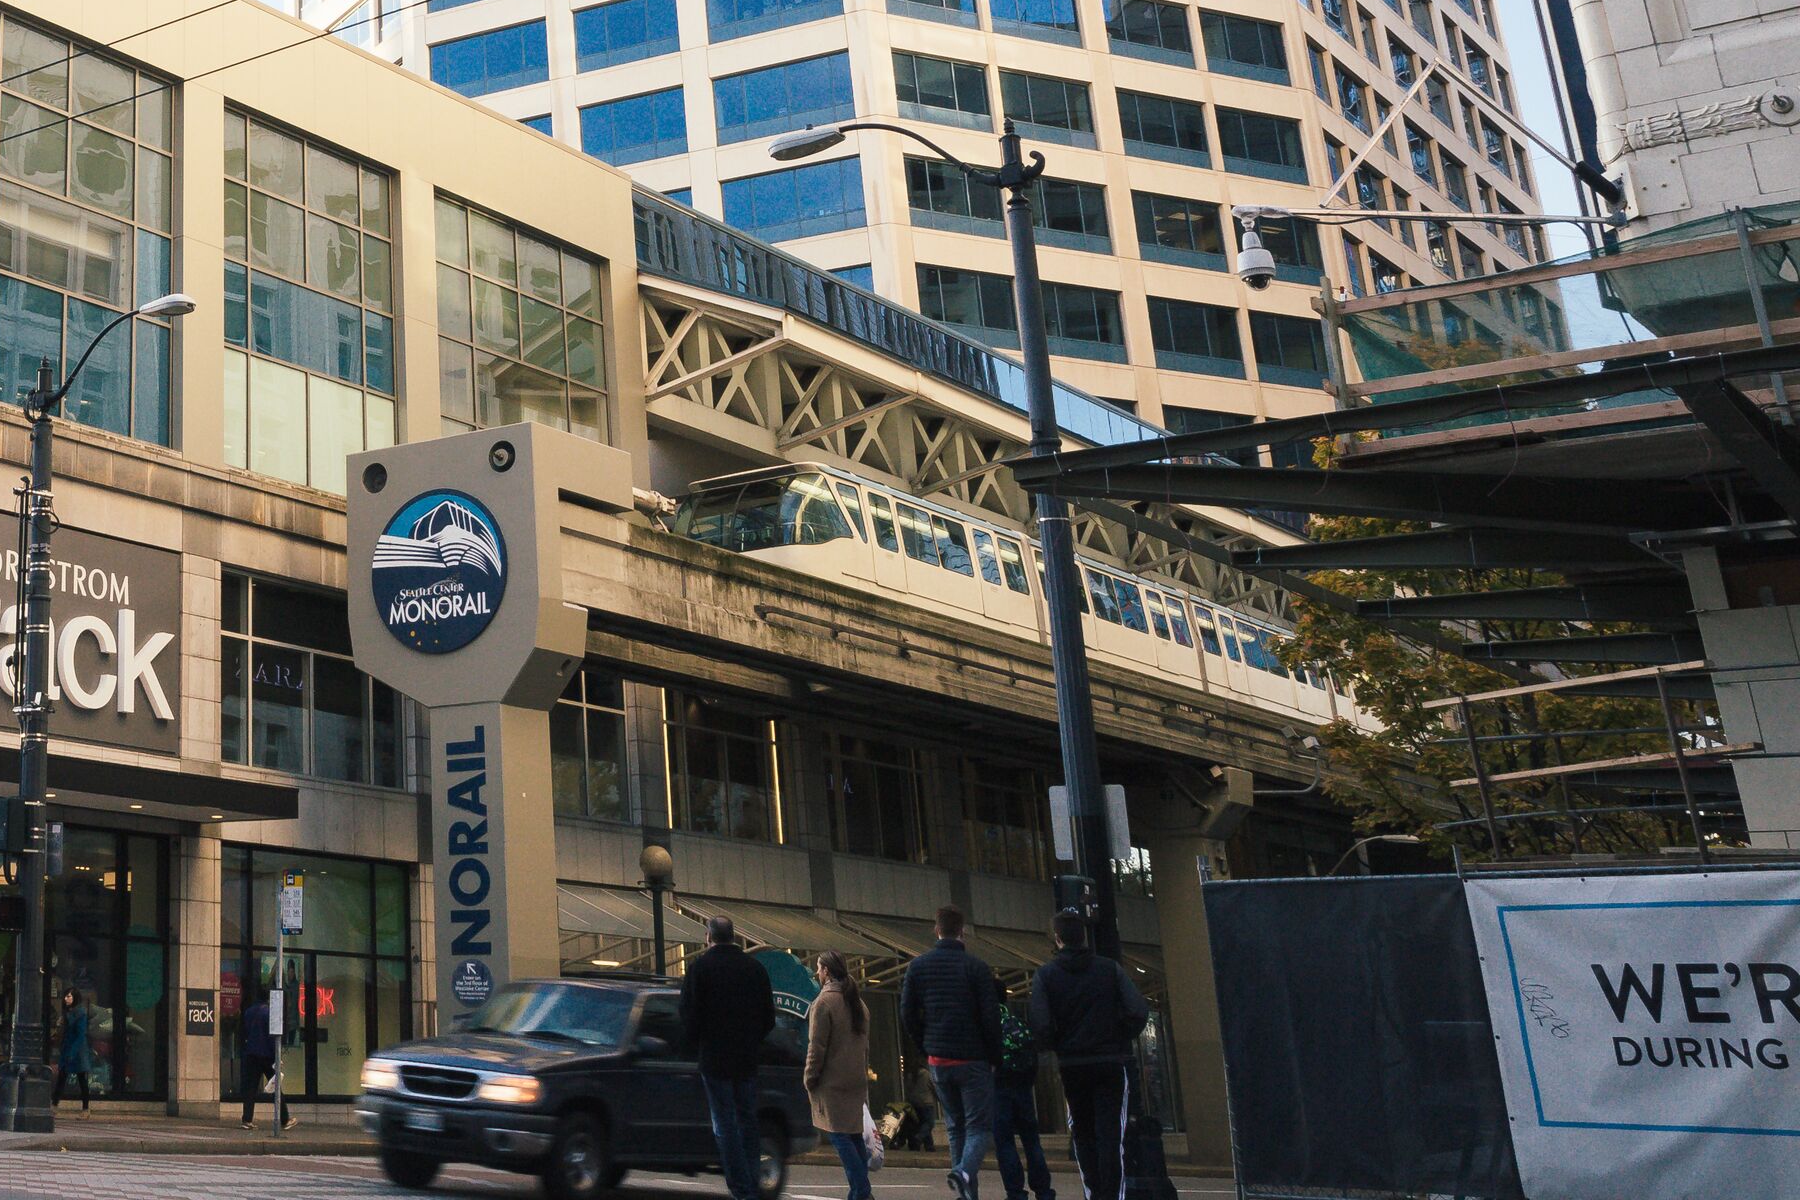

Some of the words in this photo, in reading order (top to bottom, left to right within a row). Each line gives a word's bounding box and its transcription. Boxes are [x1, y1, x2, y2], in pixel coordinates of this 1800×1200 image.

[389, 591, 491, 625] MONORAIL
[399, 587, 433, 601] SEATTLE
[433, 583, 464, 596] CENTER
[445, 725, 492, 1024] NORAIL
[774, 997, 801, 1010] RAIL
[1590, 962, 1800, 1024] WE'R
[188, 1006, 214, 1023] rack
[1612, 1037, 1790, 1070] DURING
